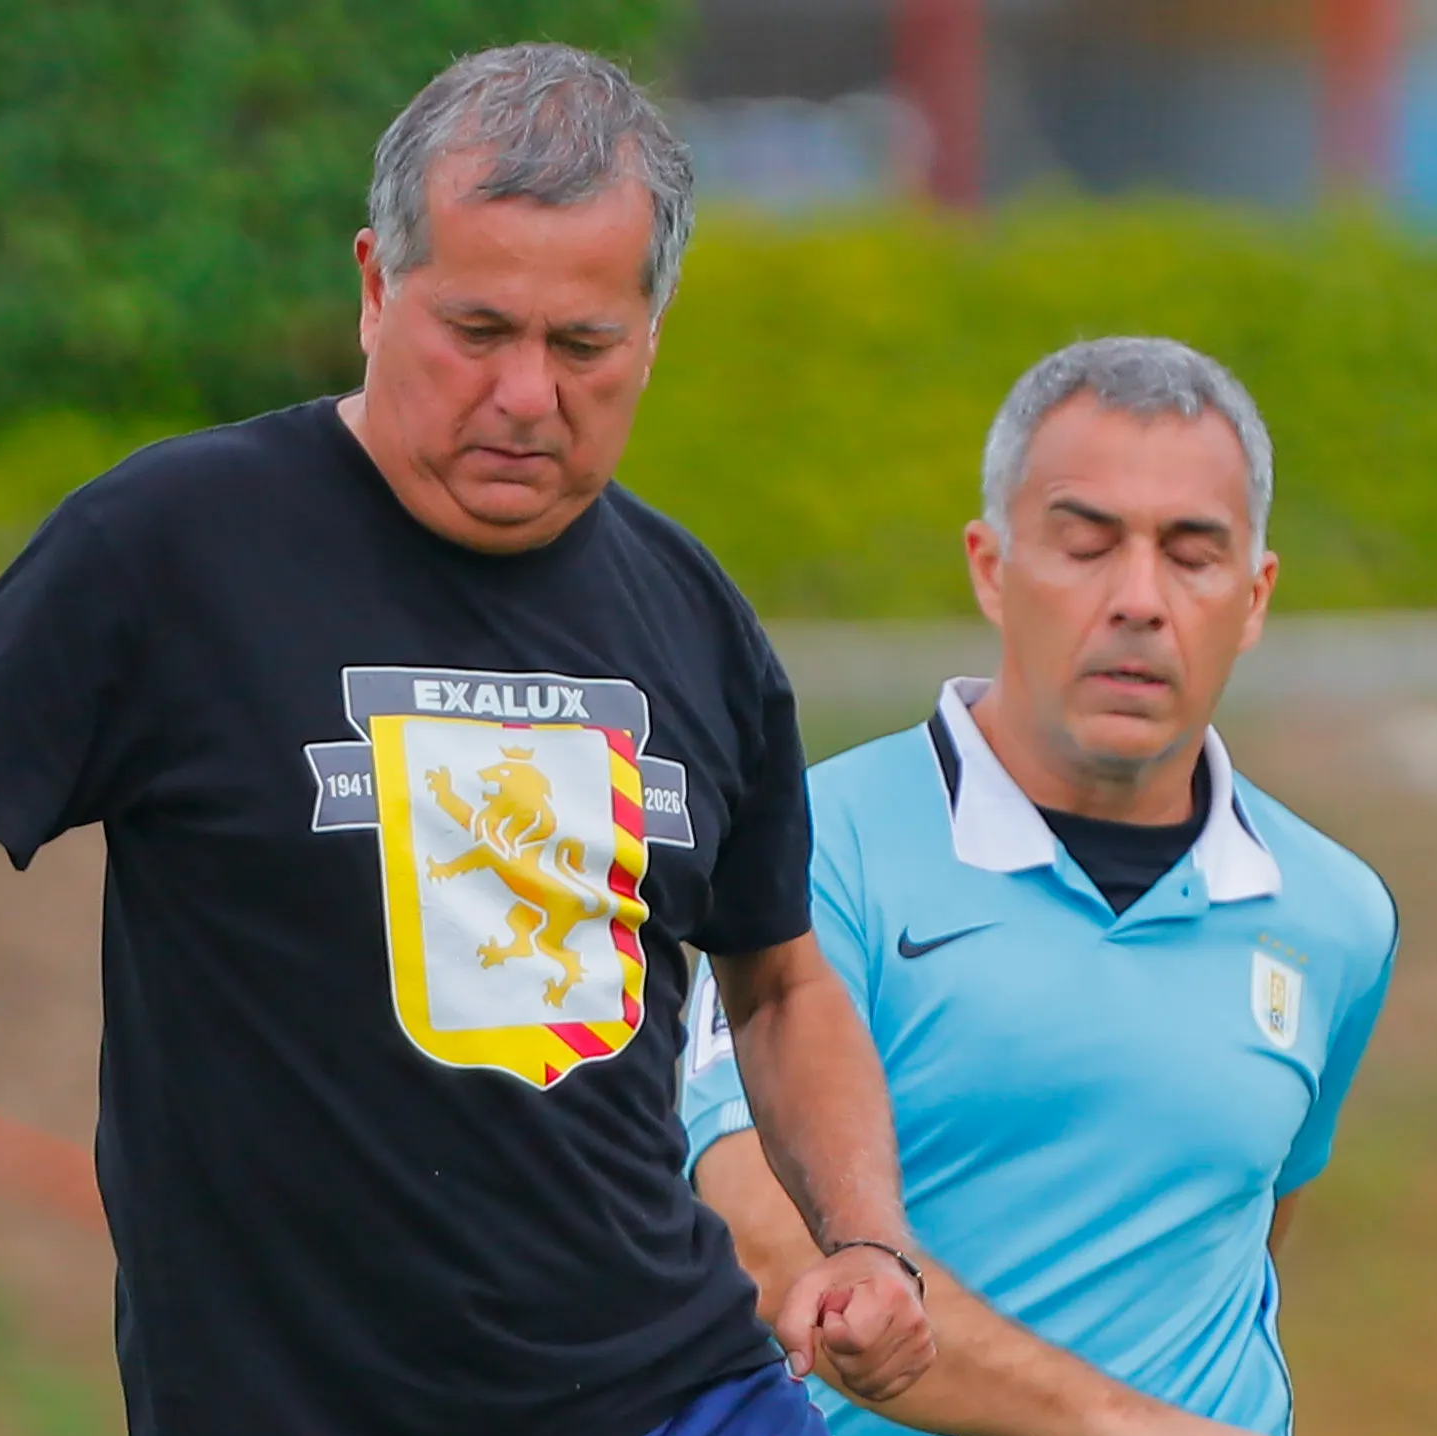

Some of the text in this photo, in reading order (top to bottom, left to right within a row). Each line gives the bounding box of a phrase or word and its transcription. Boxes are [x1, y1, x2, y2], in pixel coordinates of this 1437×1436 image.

[414, 679, 590, 719] EXALUX
[327, 772, 373, 798] 1941
[644, 787, 681, 814] 2026
